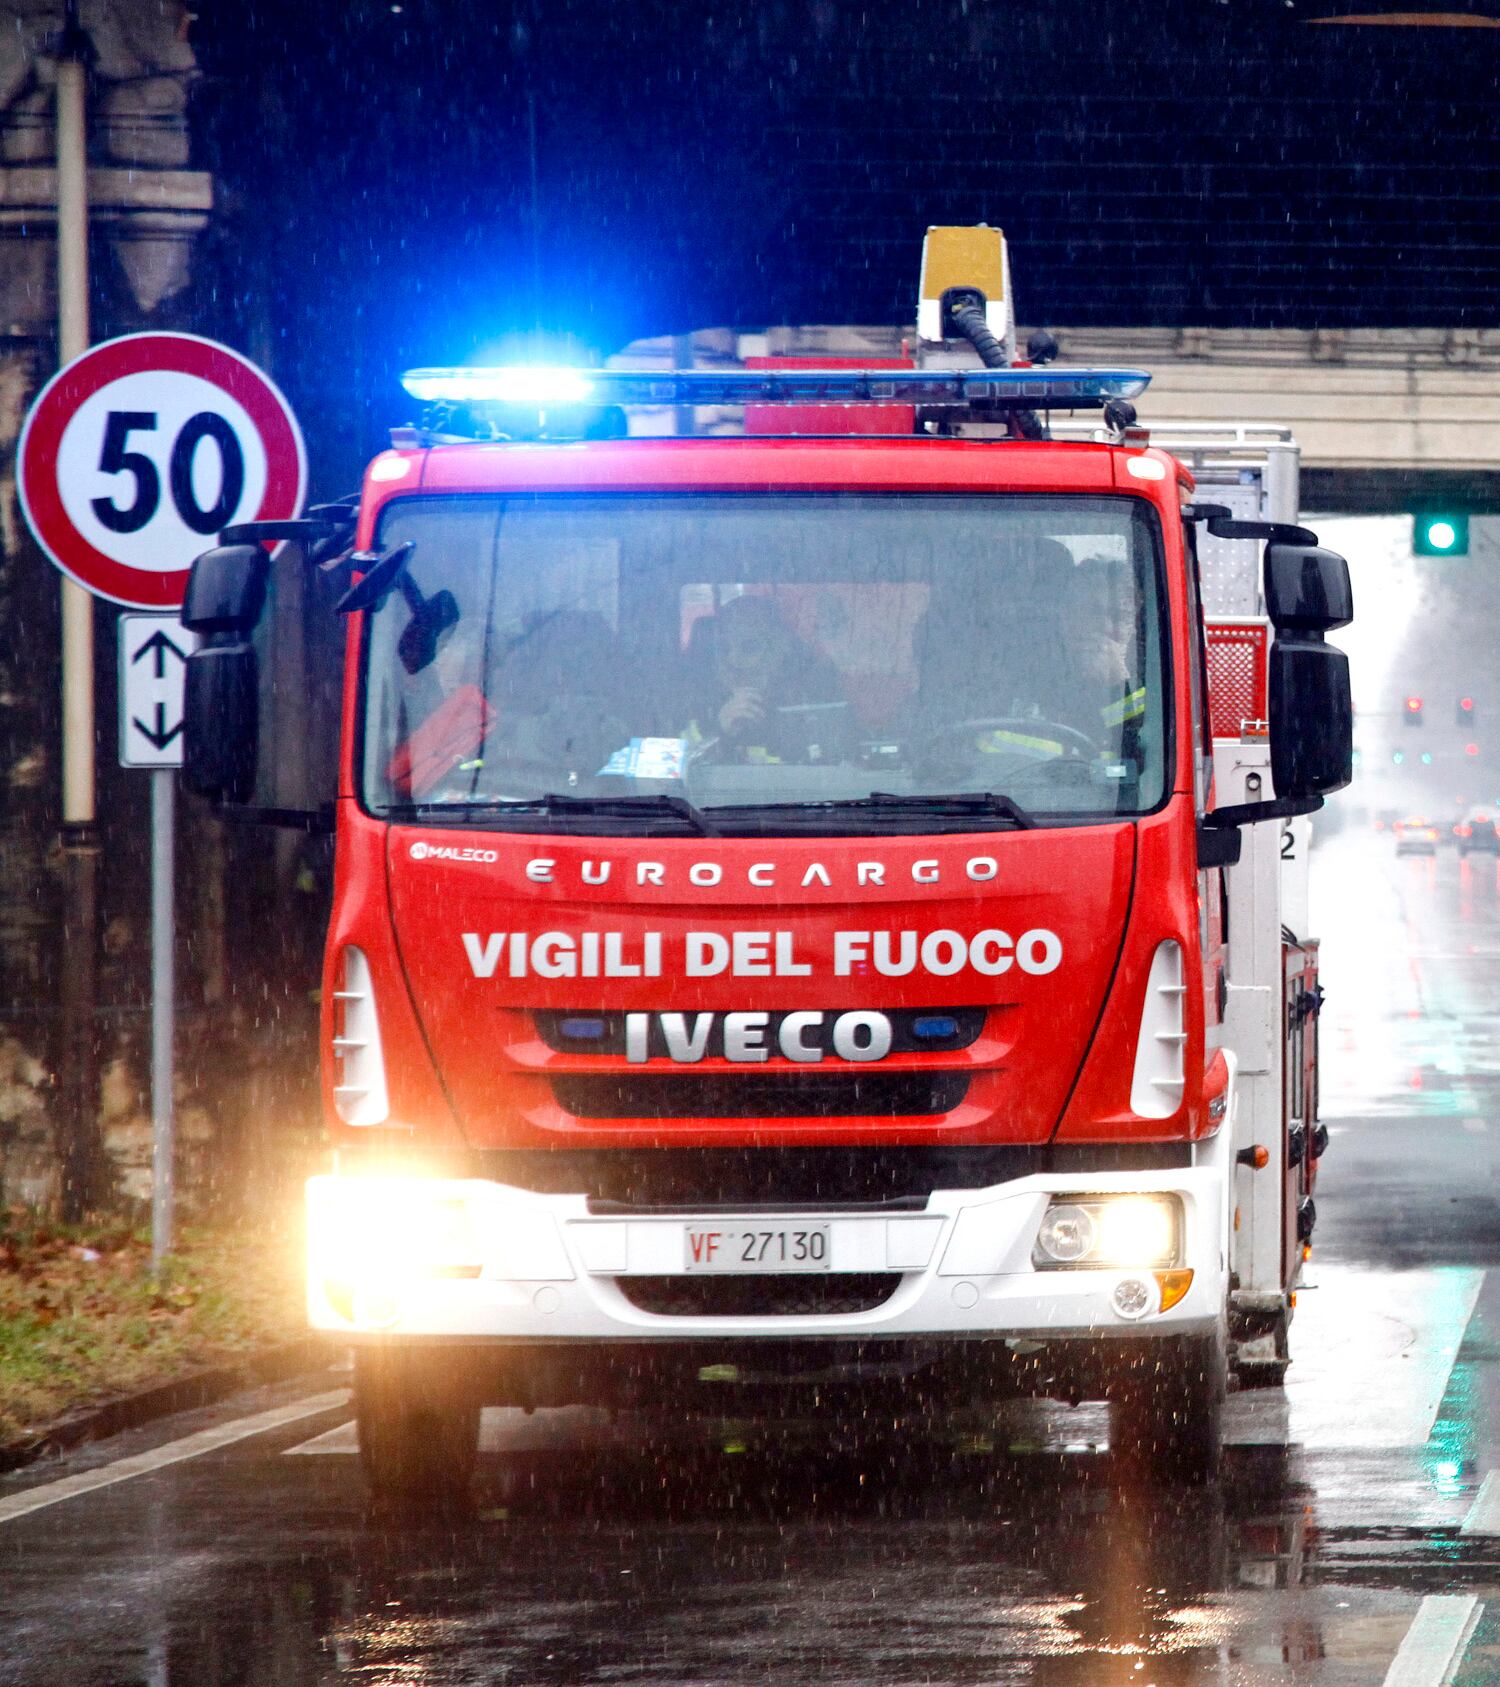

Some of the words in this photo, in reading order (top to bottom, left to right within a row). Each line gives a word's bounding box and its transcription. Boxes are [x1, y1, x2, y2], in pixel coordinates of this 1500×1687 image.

[90, 411, 245, 535] 50
[527, 857, 998, 887] EUROCARGO
[462, 932, 662, 978] VIGILI
[686, 931, 811, 976] DEL
[834, 929, 1063, 976] FUOCO
[625, 1011, 893, 1064] IVECO
[690, 1233, 721, 1263] VF
[741, 1232, 825, 1261] 27130
